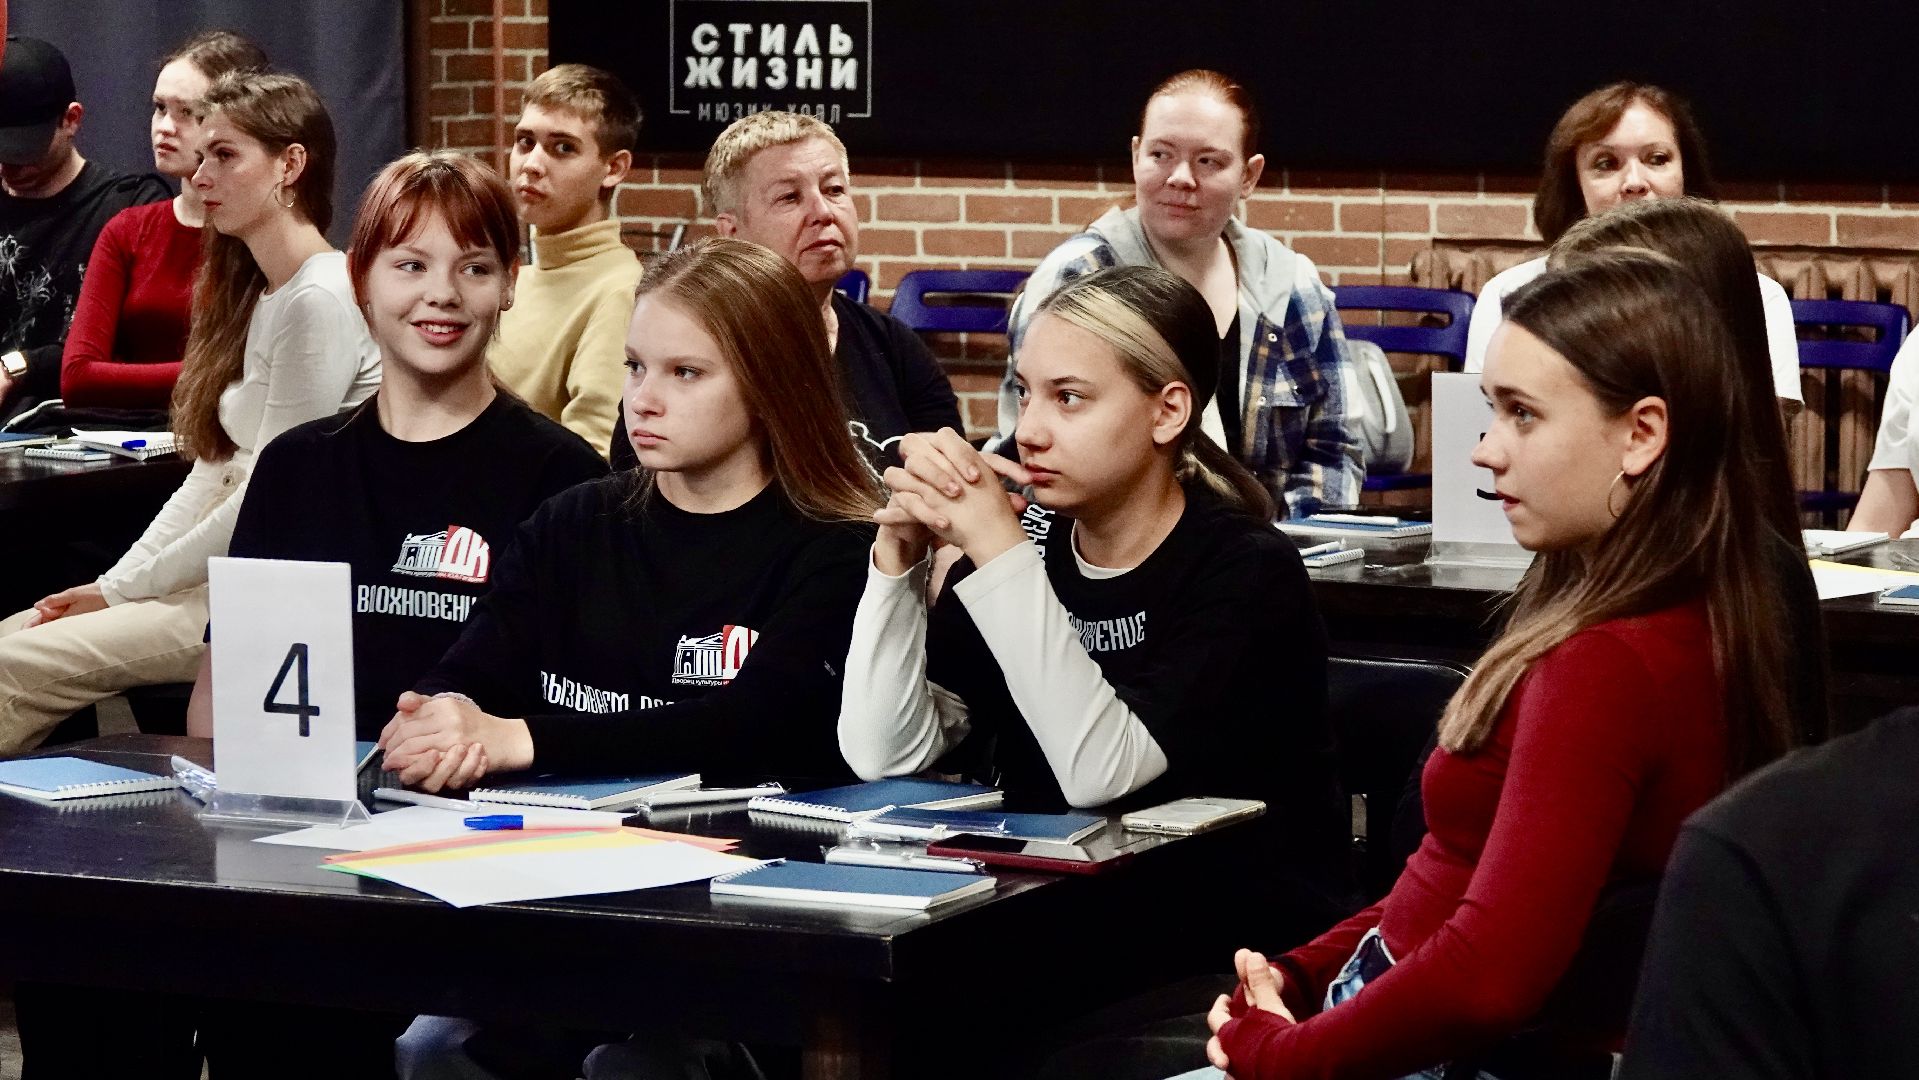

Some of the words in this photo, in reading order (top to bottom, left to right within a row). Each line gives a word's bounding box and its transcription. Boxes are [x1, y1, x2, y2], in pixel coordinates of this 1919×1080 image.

[691, 23, 853, 56] СТИЛЬ
[683, 56, 858, 90] ЖИЗНИ
[438, 526, 490, 578] ДК
[264, 642, 320, 737] 4
